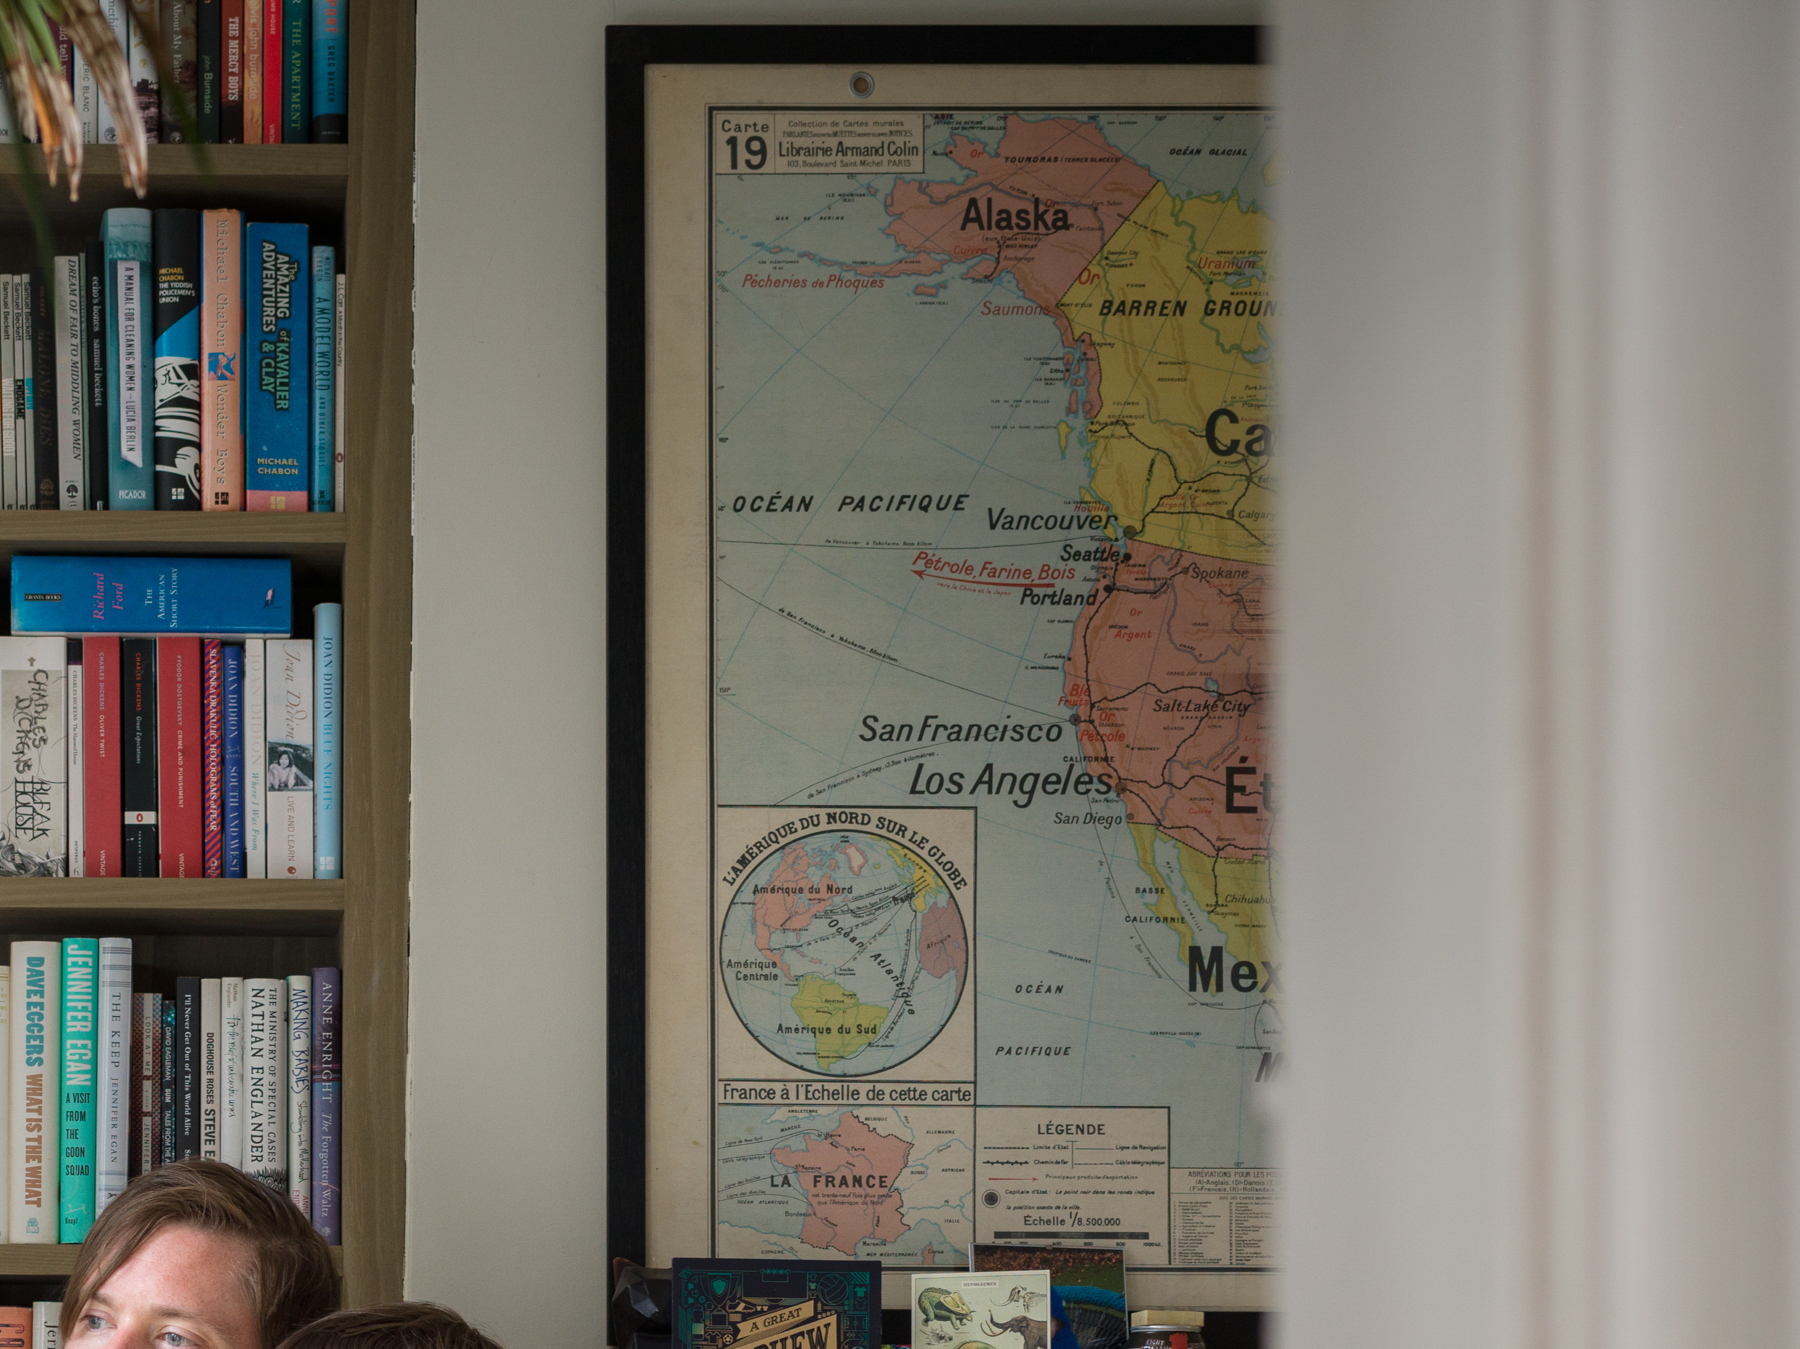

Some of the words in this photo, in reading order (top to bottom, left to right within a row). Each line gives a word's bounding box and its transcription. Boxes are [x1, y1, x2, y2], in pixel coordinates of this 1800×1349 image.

[229, 16, 239, 37] THE
[292, 19, 301, 46] THE
[228, 40, 239, 75] MERCY
[327, 46, 335, 67] GREG
[228, 77, 238, 101] BOYS
[292, 51, 301, 128] APARTMENT
[327, 70, 335, 103] BAXTER
[721, 119, 770, 133] Carte
[788, 120, 827, 128] Collection
[830, 120, 839, 128] de
[843, 120, 869, 128] Cartes
[725, 135, 768, 170] 19
[778, 141, 833, 158] Librairie
[835, 141, 885, 158] Armand
[887, 141, 919, 157] Colin
[960, 197, 1070, 232] Alaska
[217, 219, 228, 283] Michael
[288, 262, 299, 281] The
[262, 241, 276, 333] ADVENTURES
[276, 253, 289, 318] AMAZING
[742, 273, 807, 289] Pêcheries
[812, 277, 824, 288] de
[826, 274, 884, 294] Phoques
[981, 301, 1050, 316] Saumons
[1099, 300, 1188, 317] BARREN
[217, 293, 228, 348] Chabon
[280, 331, 288, 342] of
[262, 343, 274, 353] &
[262, 357, 275, 393] CLAY
[276, 342, 289, 409] KAVALIER
[217, 384, 228, 439] Wonder
[216, 449, 227, 485] Boys
[257, 457, 299, 466] MICHAEL
[258, 467, 298, 475] CHABON
[732, 491, 814, 513] OCÉAN
[837, 494, 970, 513] PACIFIQUE
[987, 507, 1118, 530] Vancouver
[1060, 544, 1121, 562] Seattle
[911, 551, 977, 579] Pétrole,
[979, 561, 1036, 583] Farine,
[1037, 563, 1076, 580] Bois
[1190, 567, 1249, 583] Spokane
[170, 567, 178, 594] STORY
[92, 572, 105, 620] Richard
[112, 582, 123, 610] Ford
[145, 587, 153, 607] THE
[157, 574, 166, 621] AMERICAN
[1020, 588, 1098, 606] Portland
[170, 597, 178, 628] SHORT
[1222, 699, 1250, 717] City
[858, 715, 914, 742] San
[917, 715, 1062, 742] Francisco
[908, 763, 966, 795] Los
[969, 763, 1112, 808] Angeles
[287, 815, 295, 831] AND
[1054, 812, 1079, 825] San
[1083, 812, 1122, 829] Diego
[287, 834, 295, 861] LEARN
[798, 812, 822, 829] DU
[825, 811, 871, 825] NORD
[875, 816, 909, 842] SUR
[908, 830, 929, 851] LE
[927, 845, 968, 891] GLOBE
[752, 884, 807, 896] Amérique
[809, 884, 823, 894] du
[826, 884, 853, 895] Nord
[1125, 915, 1186, 924] CALIFORNIE
[726, 959, 777, 972] Amérique
[735, 971, 779, 981] Centrale
[26, 957, 45, 1003] DAVE
[66, 944, 92, 1032] JENNIFER
[1015, 981, 1064, 994] OCÉAN
[321, 982, 333, 1024] ANNE
[251, 988, 265, 1058] NATHAN
[777, 1023, 832, 1038] Amérique
[838, 1024, 850, 1034] du
[856, 1024, 877, 1034] Sud
[25, 1005, 45, 1067] EGGERS
[995, 1046, 1072, 1056] PACIFIQUE
[66, 1039, 92, 1086] EGAN
[321, 1033, 333, 1104] ENRIGHT
[26, 1073, 44, 1114] WHAT
[66, 1093, 70, 1103] A
[73, 1093, 91, 1103] VISIT
[723, 1084, 776, 1100] France
[780, 1084, 790, 1100] à
[796, 1084, 861, 1101] l'Echelle
[866, 1085, 885, 1101] de
[889, 1087, 928, 1101] cette
[931, 1087, 971, 1101] carte
[26, 1116, 43, 1132] IS
[66, 1111, 86, 1122] FROM
[250, 1066, 264, 1163] ENGLANDER
[66, 1129, 79, 1140] THE
[1038, 1120, 1106, 1136] LÉGENDE
[25, 1135, 42, 1166] THE
[65, 1147, 85, 1158] GOON
[65, 1165, 90, 1176] SQUAD
[770, 1175, 791, 1188] LA
[813, 1175, 889, 1188] FRANCE
[25, 1166, 42, 1208] WHAT
[1024, 1214, 1066, 1226] Échelle
[750, 1322, 759, 1332] A
[762, 1308, 803, 1328] GREAT
